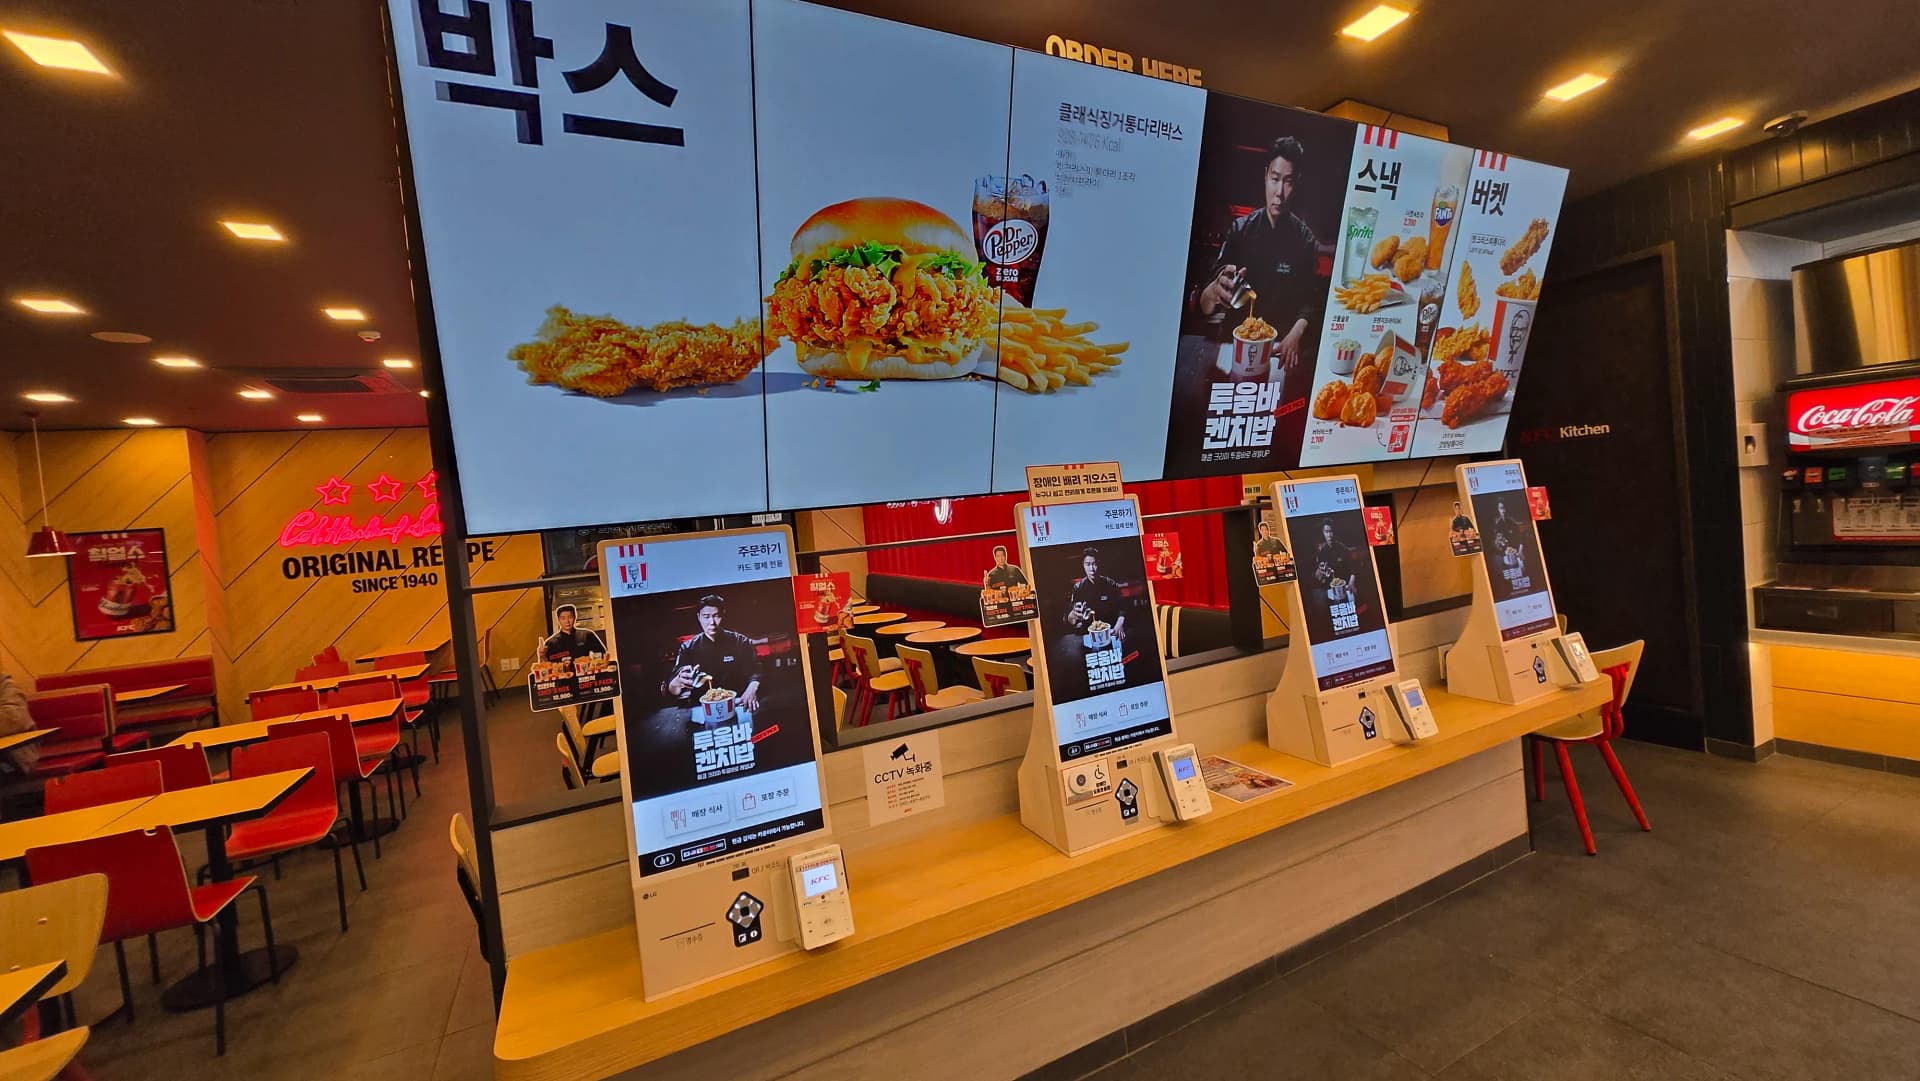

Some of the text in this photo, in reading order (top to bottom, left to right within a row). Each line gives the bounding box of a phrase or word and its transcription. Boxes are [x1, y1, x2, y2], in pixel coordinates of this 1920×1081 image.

[1045, 34, 1202, 86] ORDER HERE
[412, 0, 686, 147] 박스
[1059, 102, 1183, 141] 클래식징거통다리박스
[1354, 159, 1402, 200] 스낵
[1471, 179, 1509, 216] 버켓
[987, 230, 1033, 259] Pepper
[1208, 381, 1280, 415] 투움바
[1798, 395, 1920, 432] Coca-Cola
[1202, 414, 1277, 449] 켄치밥
[1560, 424, 1610, 438] Kitchen
[1033, 473, 1118, 488] 장애인 배려 키오스크
[1036, 490, 1052, 498] 누구나
[1105, 507, 1133, 519] 주문하기
[282, 541, 494, 579] ORIGINAL REPE
[738, 542, 782, 558] 주문하기
[737, 564, 752, 572] 카드
[352, 572, 438, 593] SINCE 1940
[627, 582, 644, 590] KFC
[1330, 602, 1356, 618] 투움바
[1332, 613, 1360, 631] 켄치밥
[1085, 647, 1123, 669] 투움바
[1087, 662, 1126, 686] 켄치밥
[693, 722, 753, 751] 투움바
[695, 741, 755, 773] 켄치밥
[874, 761, 933, 784] CCTV 녹화중
[761, 792, 775, 801] 포장
[708, 804, 723, 814] 식사
[811, 873, 831, 886] KFC
